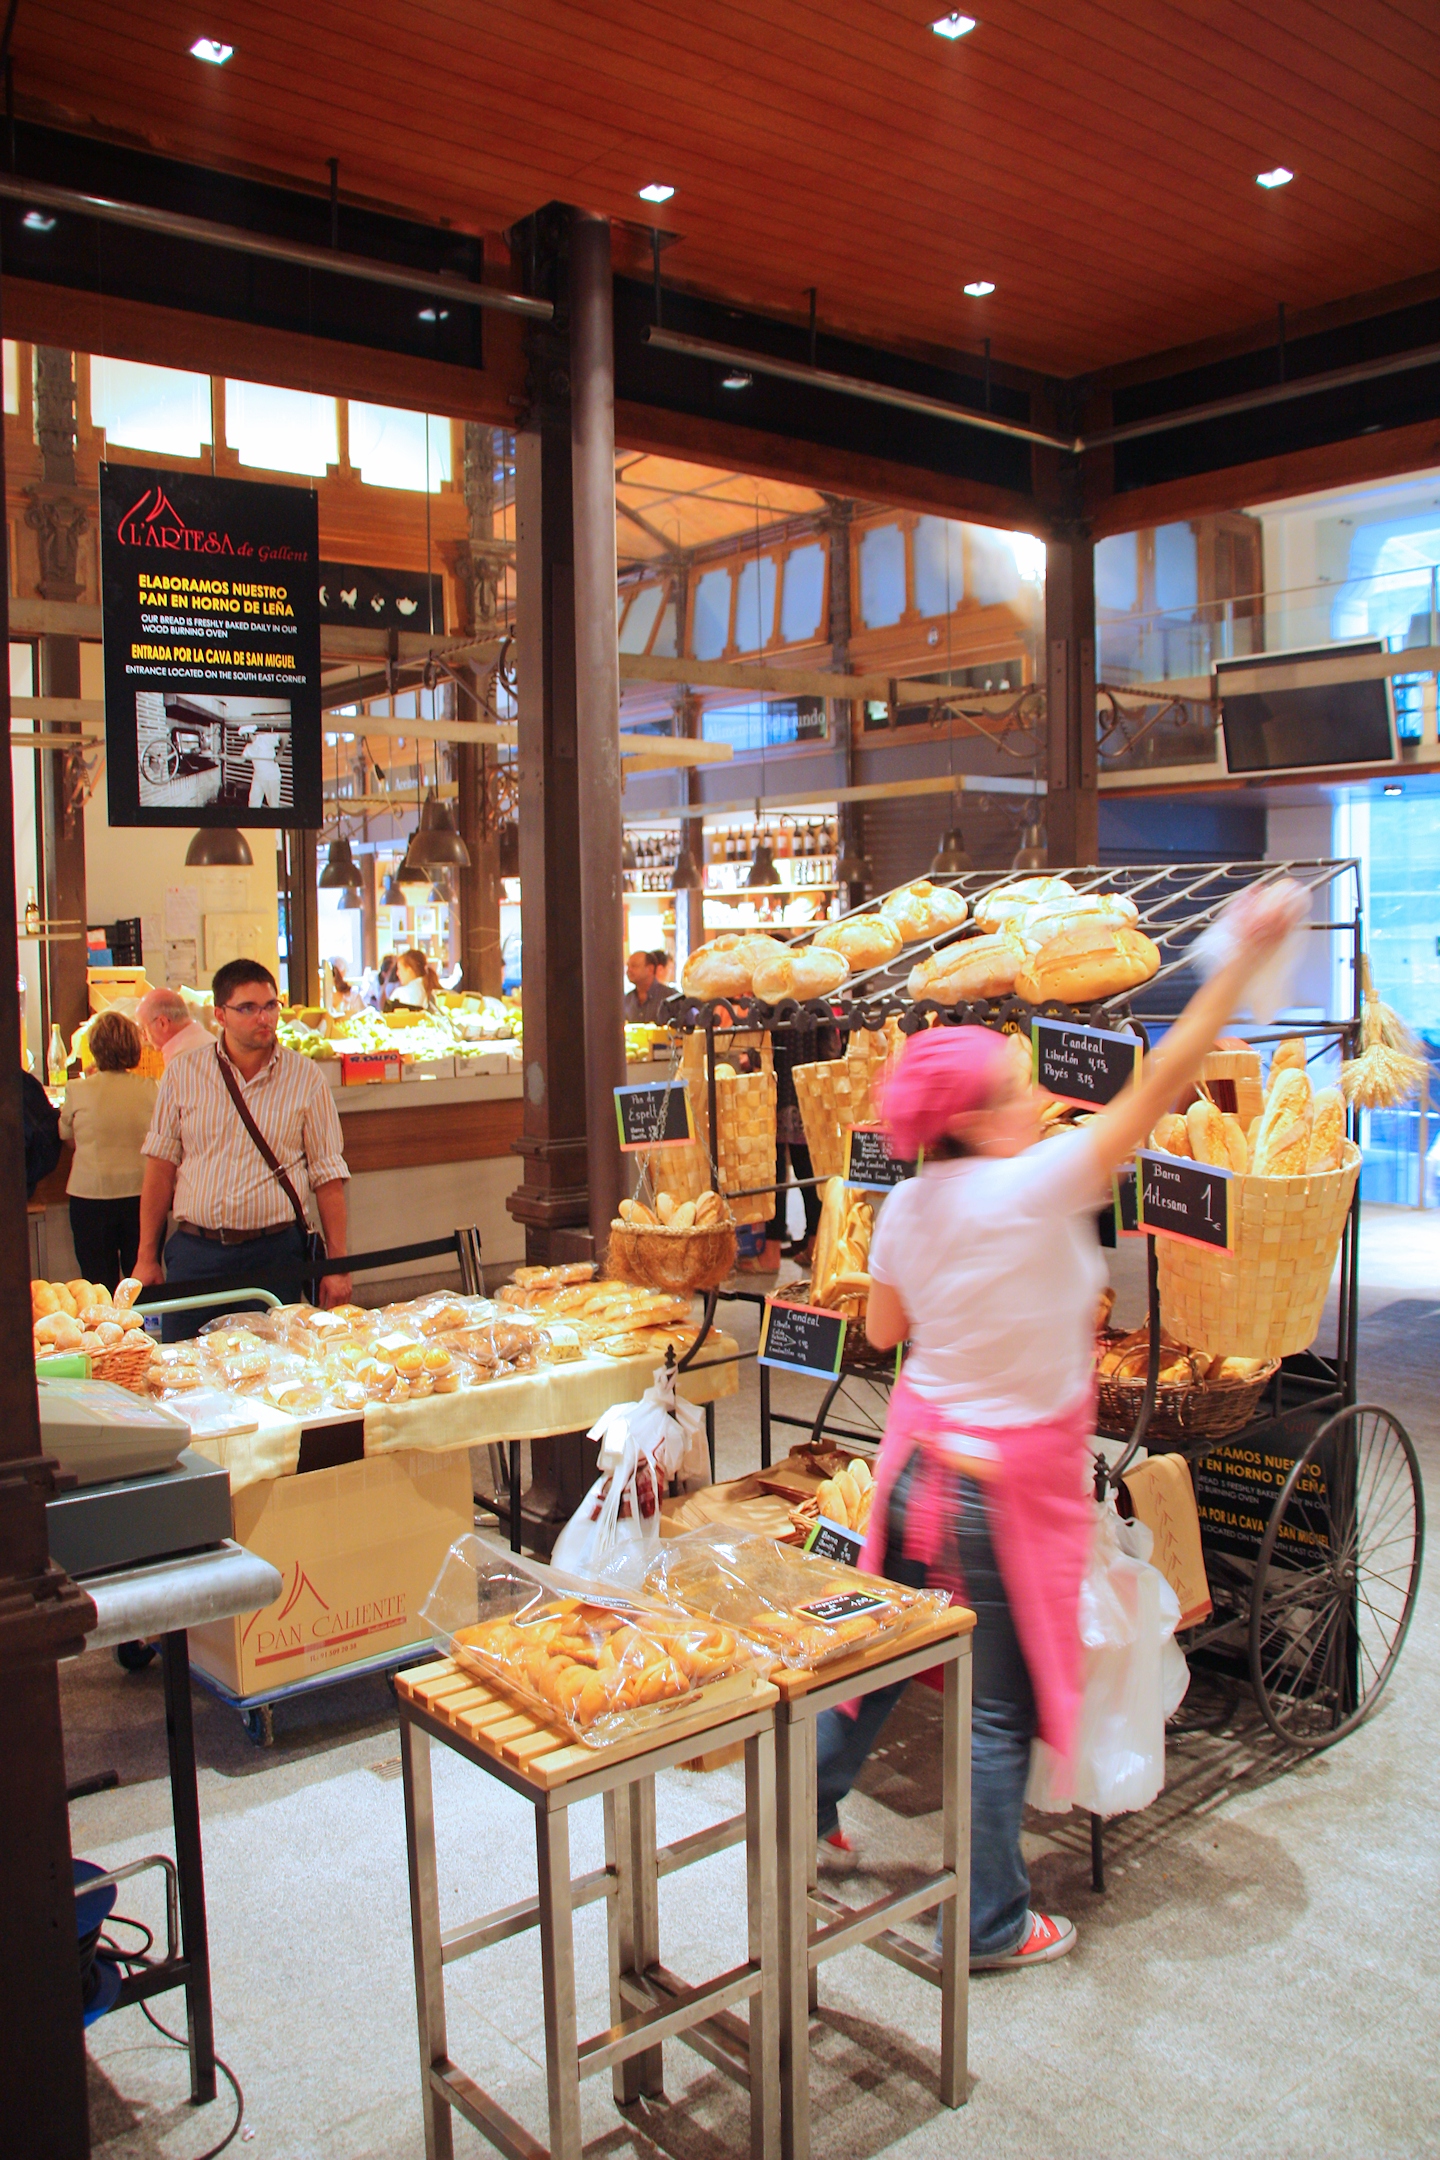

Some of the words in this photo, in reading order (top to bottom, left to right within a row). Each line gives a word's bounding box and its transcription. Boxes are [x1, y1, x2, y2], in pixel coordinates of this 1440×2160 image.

[129, 521, 236, 556] L'ARTESA
[237, 542, 254, 557] de
[257, 545, 309, 563] Gallent
[138, 573, 229, 595] ELABORAMOS
[232, 582, 288, 601] NUESTRO
[139, 591, 168, 607] PAN
[171, 594, 189, 609] EN
[191, 596, 241, 613] HORNO
[243, 600, 260, 615] DE
[262, 599, 295, 617] LEÑA
[140, 613, 159, 624] OUR
[160, 615, 186, 626] BREAD
[186, 617, 193, 626] IS
[194, 618, 224, 629] FRESHLY
[225, 620, 249, 631] BAKED
[250, 622, 272, 632] DAILY
[272, 624, 281, 633] IN
[281, 625, 298, 634] OUR
[141, 623, 169, 634] WOOD
[170, 626, 205, 637] BURNING
[205, 628, 229, 639] OVEN
[131, 643, 172, 661] ENTRADA
[173, 646, 192, 662] POR
[193, 648, 205, 663] LA
[205, 648, 232, 665] CAVA
[233, 651, 245, 666] DE
[246, 651, 264, 667] SAN
[264, 653, 296, 669] MIGUEL
[125, 664, 167, 676] ENTRANCE
[168, 667, 204, 679] LOCATED
[204, 669, 218, 679] ON
[219, 670, 232, 681] THE
[232, 671, 257, 682] SOUTH
[257, 673, 275, 683] EAST
[275, 674, 307, 685] CORNER
[1061, 1032, 1105, 1055] Candeal
[1044, 1048, 1079, 1065] Libretón
[1044, 1063, 1069, 1081] Payés
[631, 1094, 644, 1105] Pan
[628, 1104, 660, 1125] Espelt
[1152, 1163, 1182, 1183] Barra
[1142, 1182, 1189, 1215] Artesana
[787, 1310, 819, 1327] Candeal
[1206, 1459, 1223, 1473] EN
[1225, 1462, 1273, 1484] HORNO
[1264, 1455, 1323, 1478] NUESO
[1205, 1484, 1237, 1500] BURNING
[1237, 1494, 1260, 1505] OVEN
[1226, 1480, 1256, 1495] FRESHLY
[1202, 1523, 1236, 1538] LOCATED
[1236, 1531, 1250, 1541] ON
[1208, 1507, 1227, 1524] POR
[1227, 1512, 1238, 1527] LA
[1239, 1515, 1265, 1533] CAVA
[1277, 1525, 1297, 1541] SAN
[257, 1622, 303, 1654] PAN
[311, 1593, 407, 1638] CALIENTE
